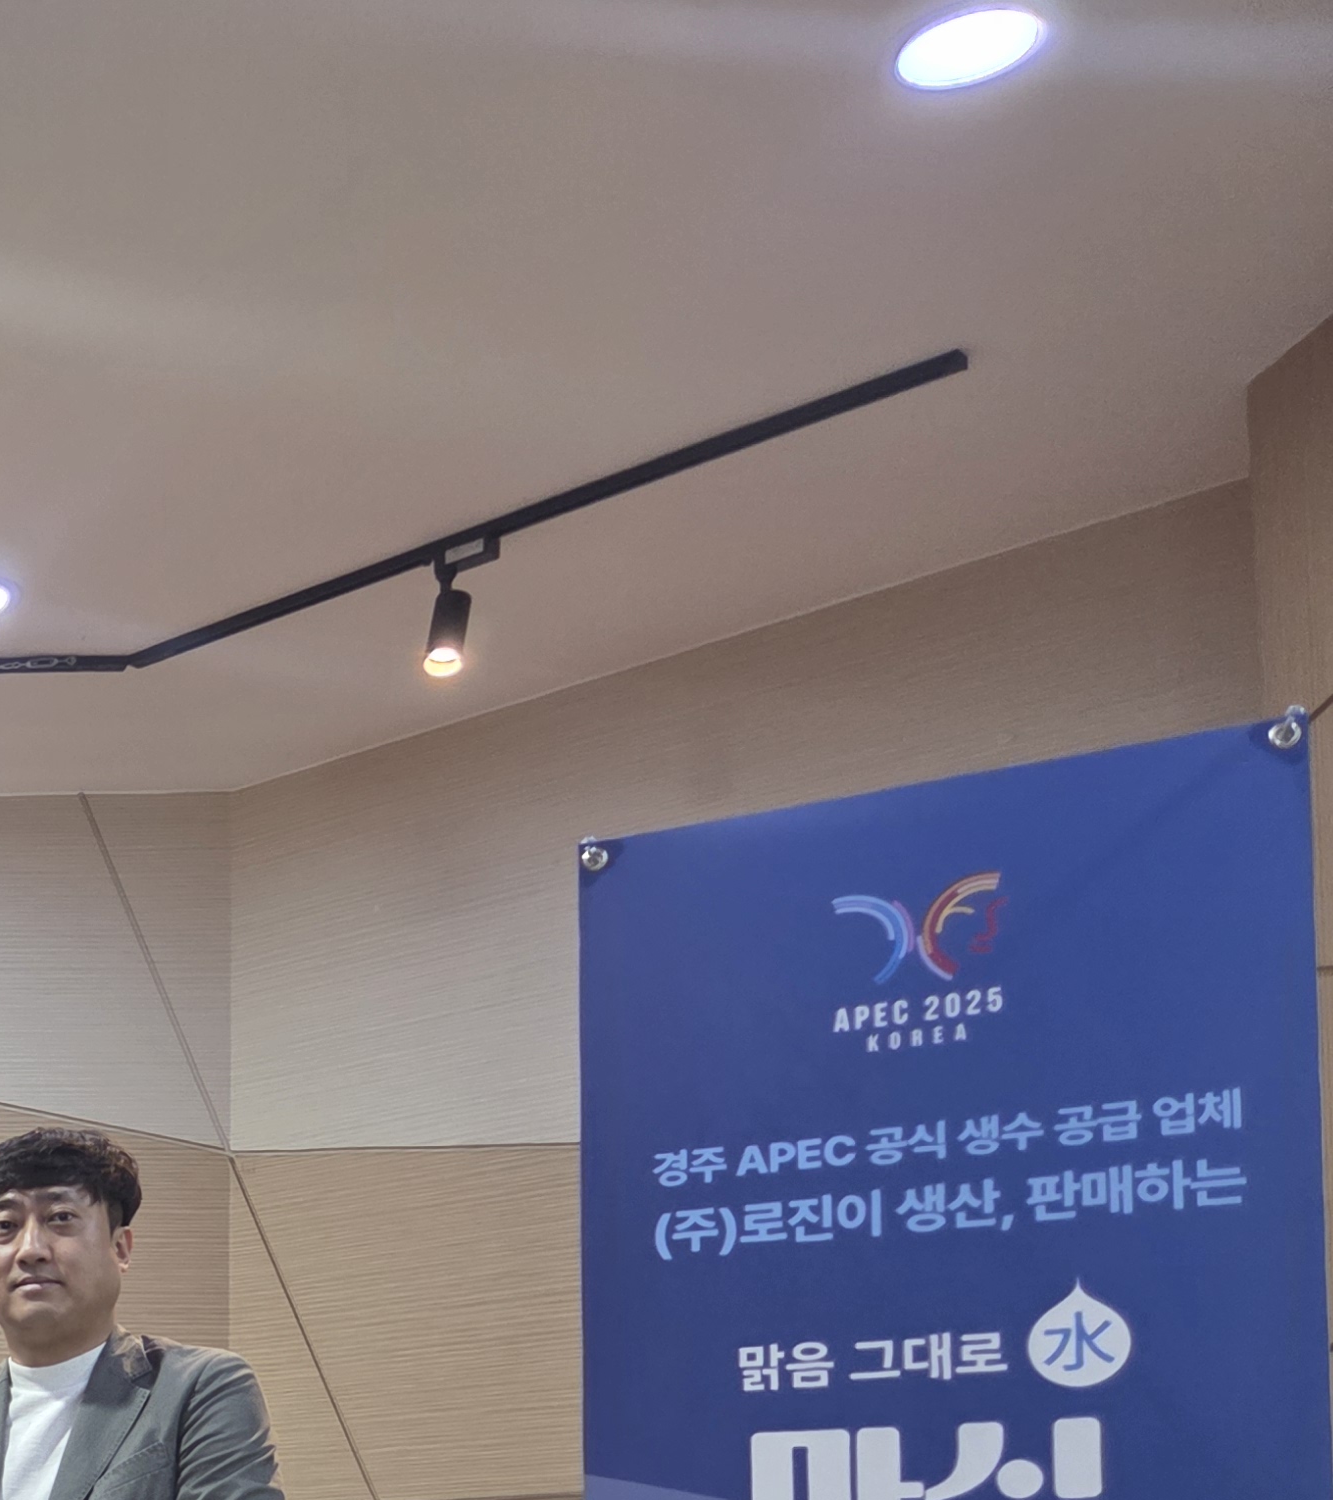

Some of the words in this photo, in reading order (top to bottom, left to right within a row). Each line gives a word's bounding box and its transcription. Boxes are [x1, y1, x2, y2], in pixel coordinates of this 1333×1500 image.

[833, 999, 910, 1033] APEC
[923, 985, 1005, 1022] 2025
[866, 1022, 969, 1053] KOREA
[653, 1145, 728, 1188] 경주
[736, 1134, 857, 1177] APEC
[865, 1119, 948, 1167] 공식
[957, 1112, 1044, 1156] 생수
[1053, 1098, 1143, 1148] 공급
[1153, 1086, 1244, 1136] 업체
[654, 1188, 883, 1261] (주)로진이
[895, 1178, 1016, 1234] 생산,
[1026, 1158, 1248, 1223] 판매하는
[737, 1340, 835, 1392] 맑음
[849, 1331, 1009, 1381] 그대로
[1042, 1309, 1116, 1373] 水
